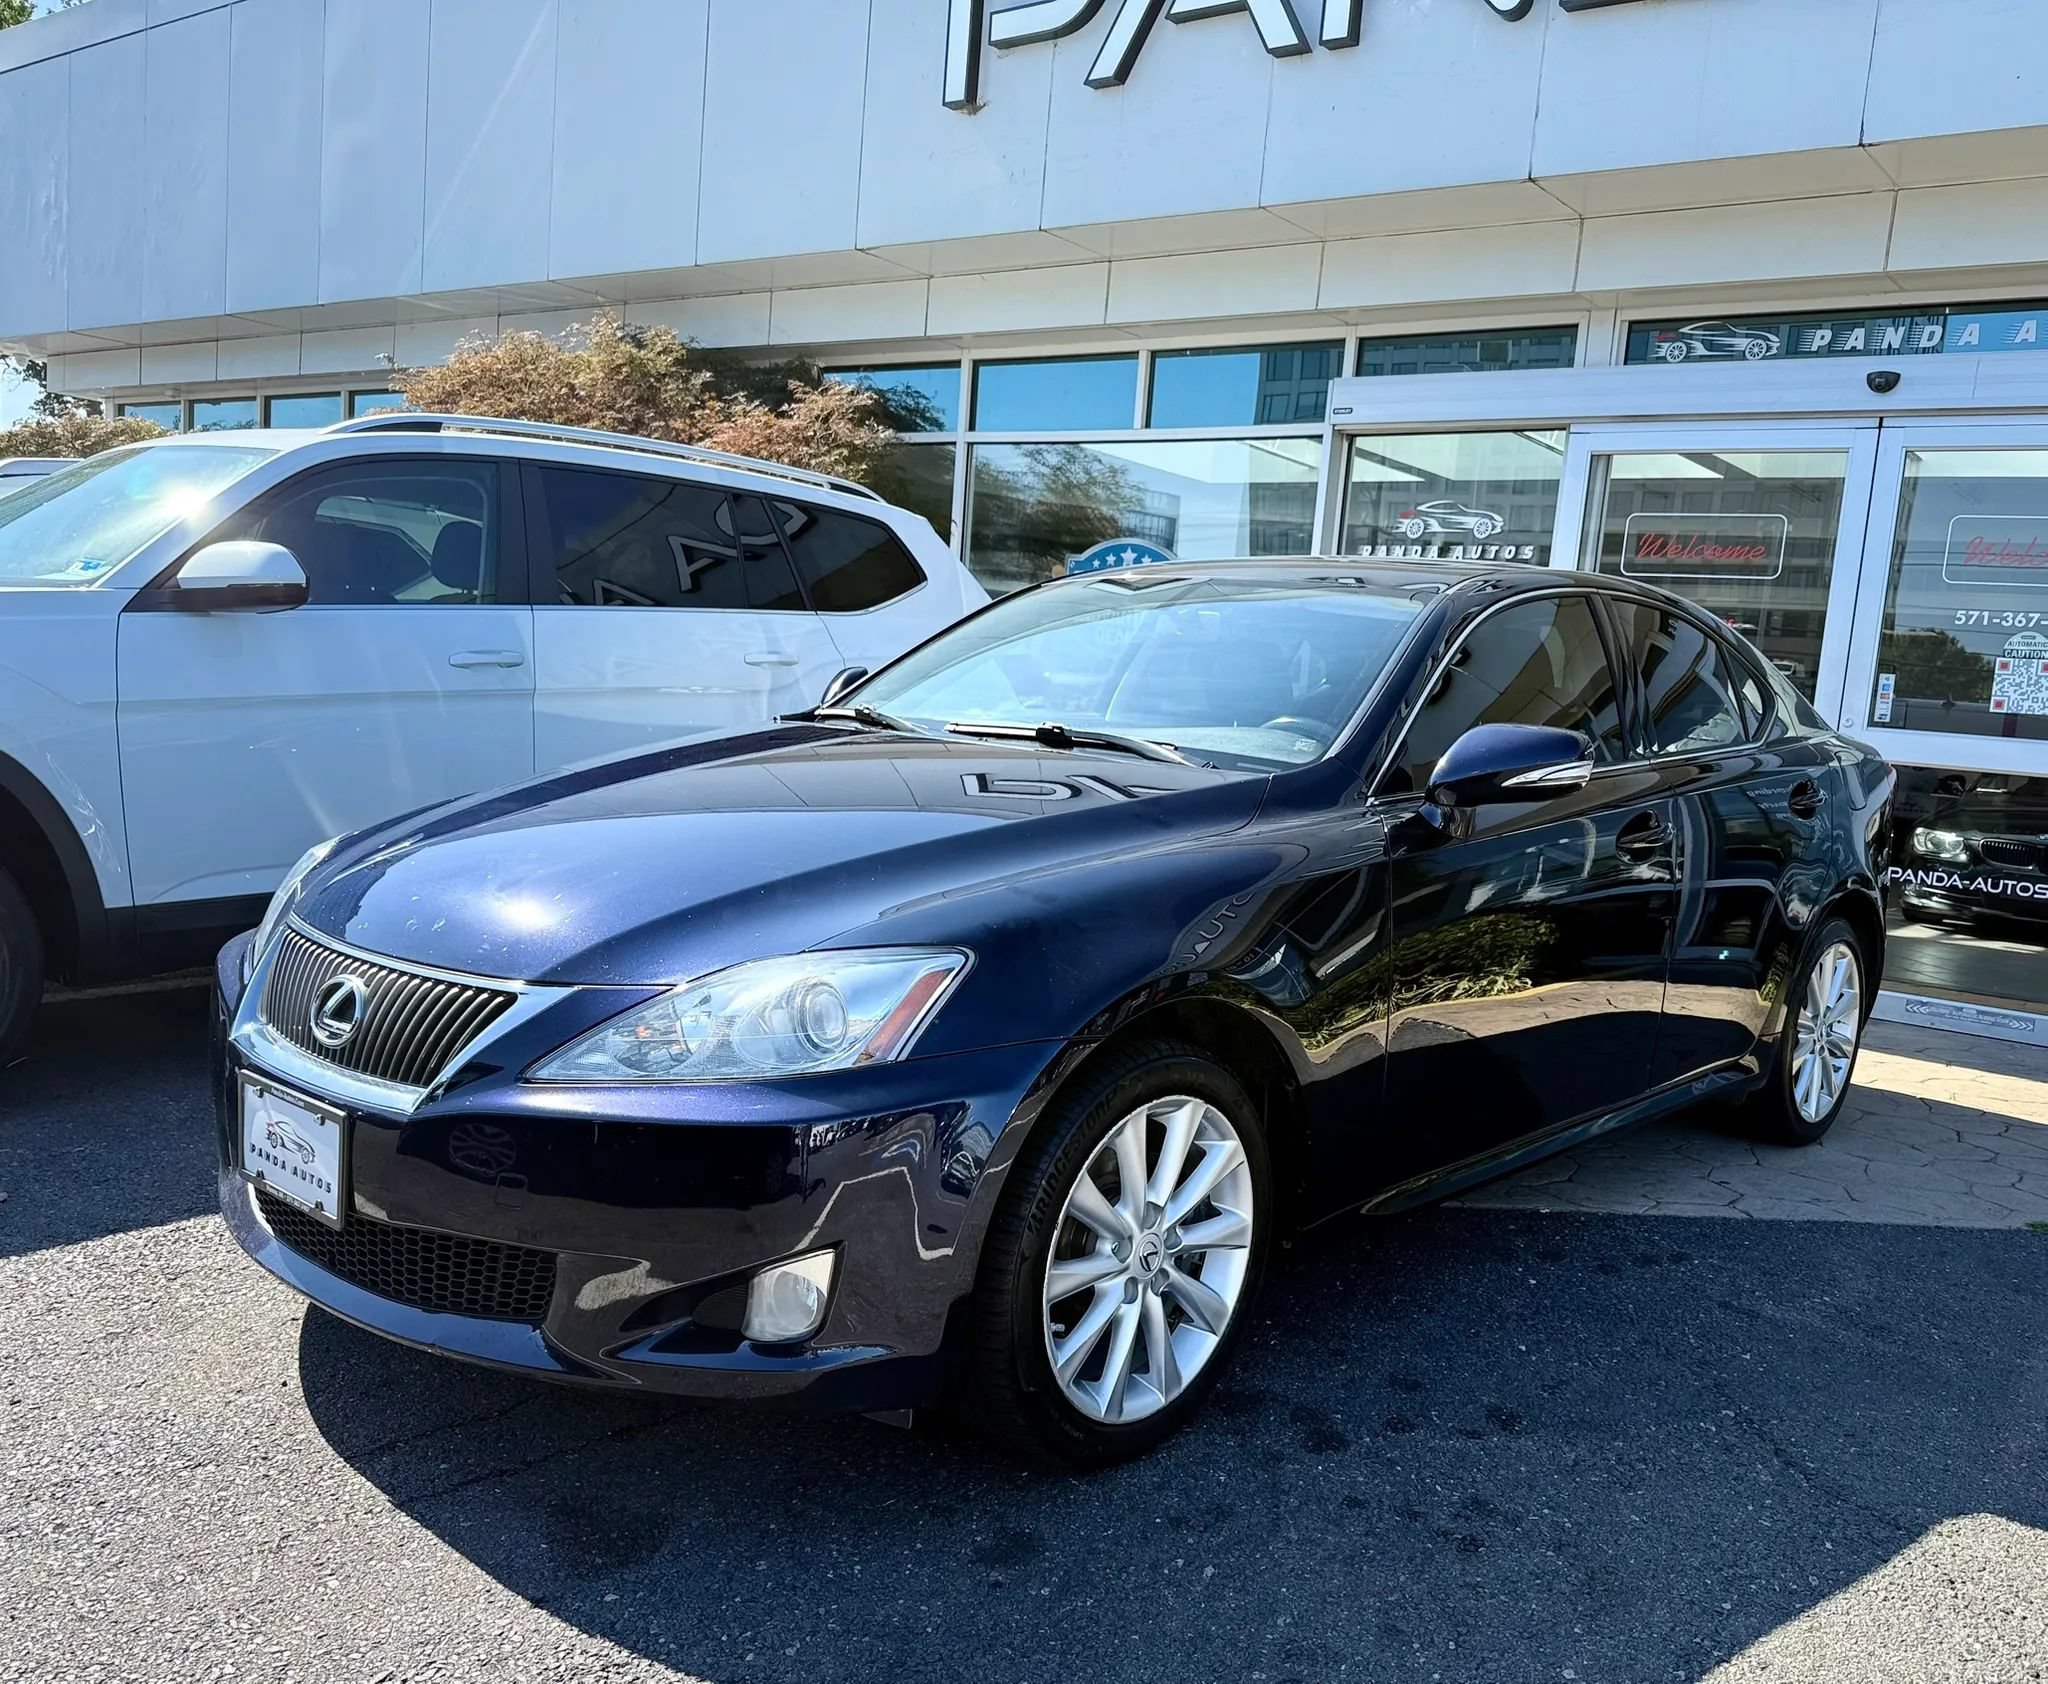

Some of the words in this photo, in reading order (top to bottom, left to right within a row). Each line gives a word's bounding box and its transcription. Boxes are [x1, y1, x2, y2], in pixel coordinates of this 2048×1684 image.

[1797, 323, 1980, 351] PANDA
[2001, 318, 2048, 343] A
[1449, 545, 1536, 560] AUTOS
[1637, 530, 1767, 561] Welcome
[2004, 649, 2048, 659] CAUTION
[250, 1142, 287, 1171] PANDA
[292, 1166, 332, 1194] AUTOS
